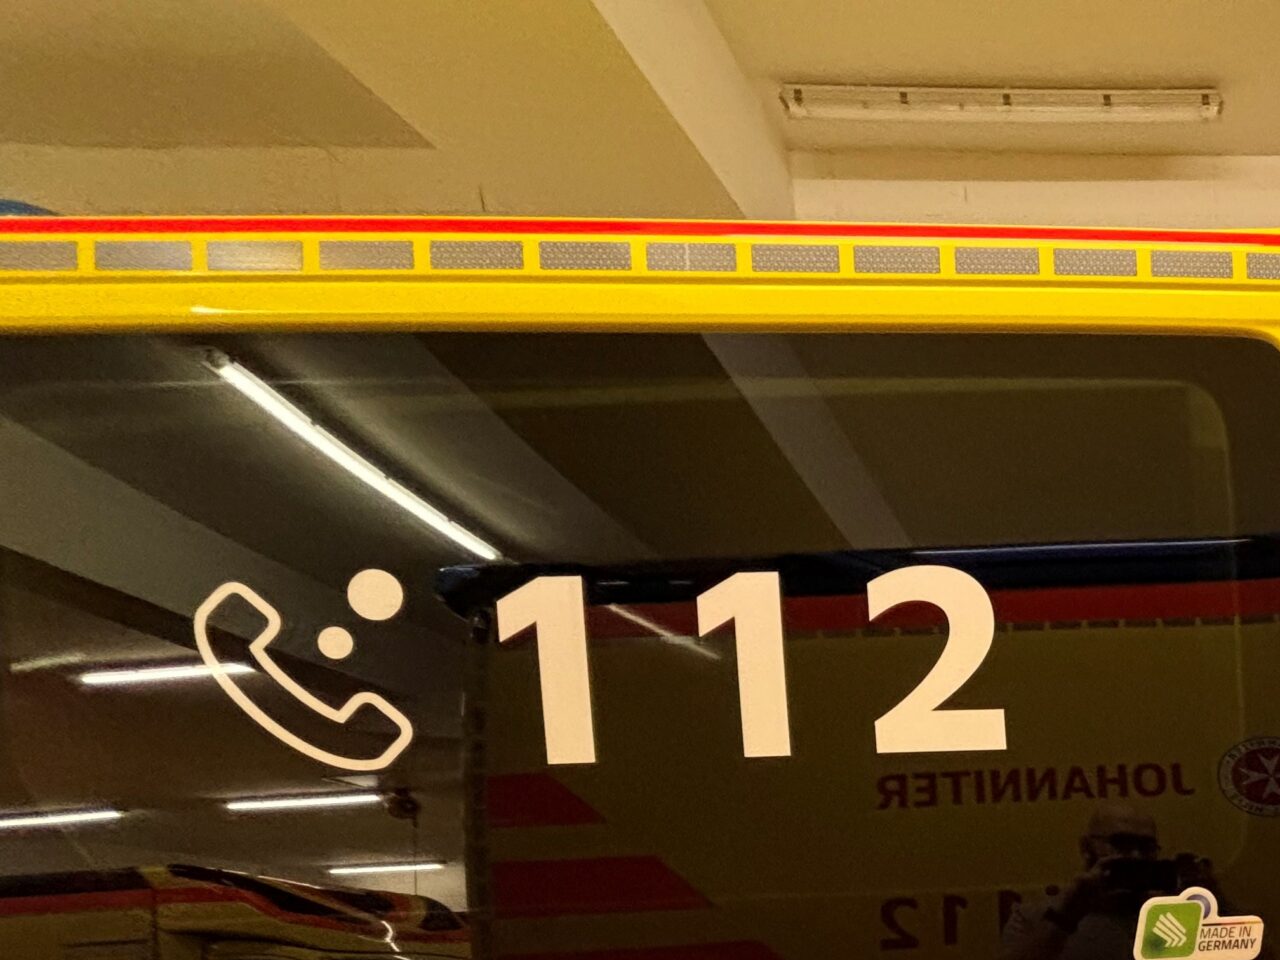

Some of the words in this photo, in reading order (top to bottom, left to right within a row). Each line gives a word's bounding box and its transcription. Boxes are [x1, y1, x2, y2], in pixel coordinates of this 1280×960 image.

[496, 564, 1008, 765] 112
[1200, 927, 1236, 939] MADE
[1239, 926, 1252, 938] IN
[1198, 938, 1257, 952] GERMANY
